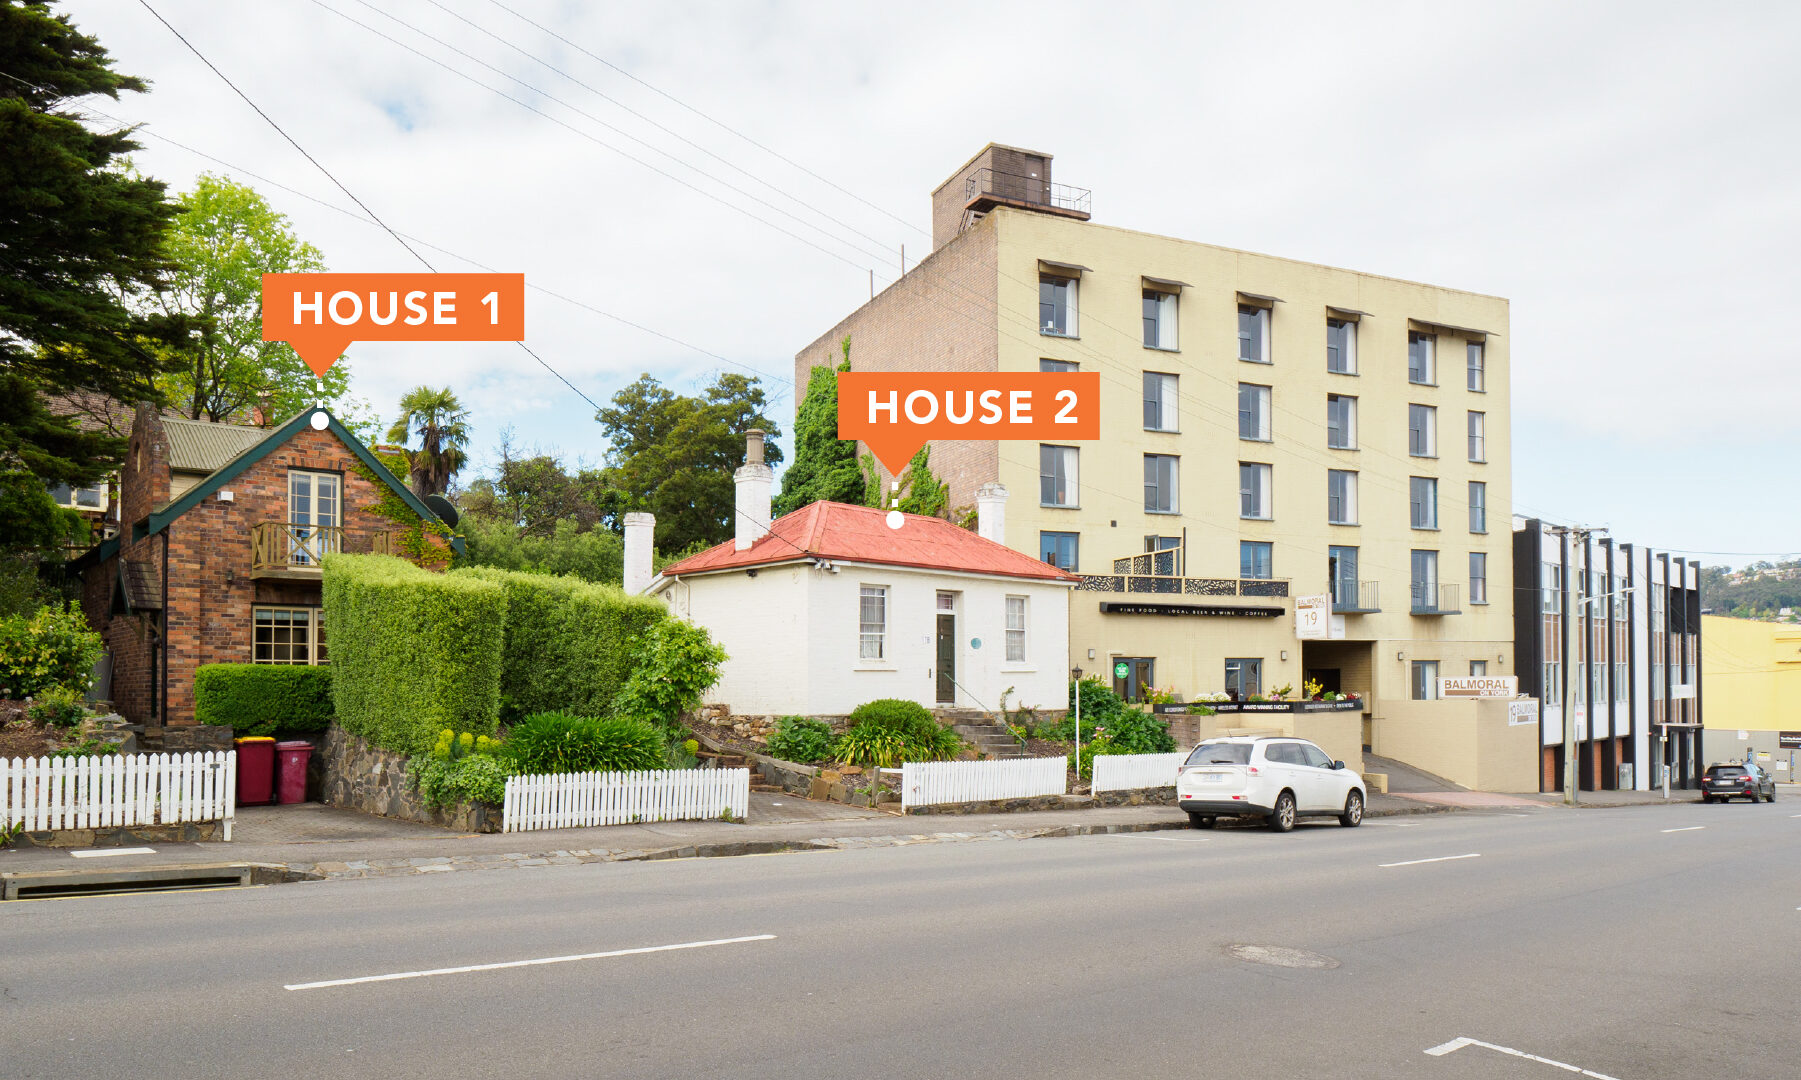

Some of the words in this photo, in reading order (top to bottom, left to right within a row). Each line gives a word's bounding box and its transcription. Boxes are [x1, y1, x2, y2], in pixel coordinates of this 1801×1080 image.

[1304, 611, 1318, 626] 19
[1444, 679, 1510, 689] BALMORAL
[1480, 689, 1490, 697] ON
[1491, 689, 1510, 697] YORK
